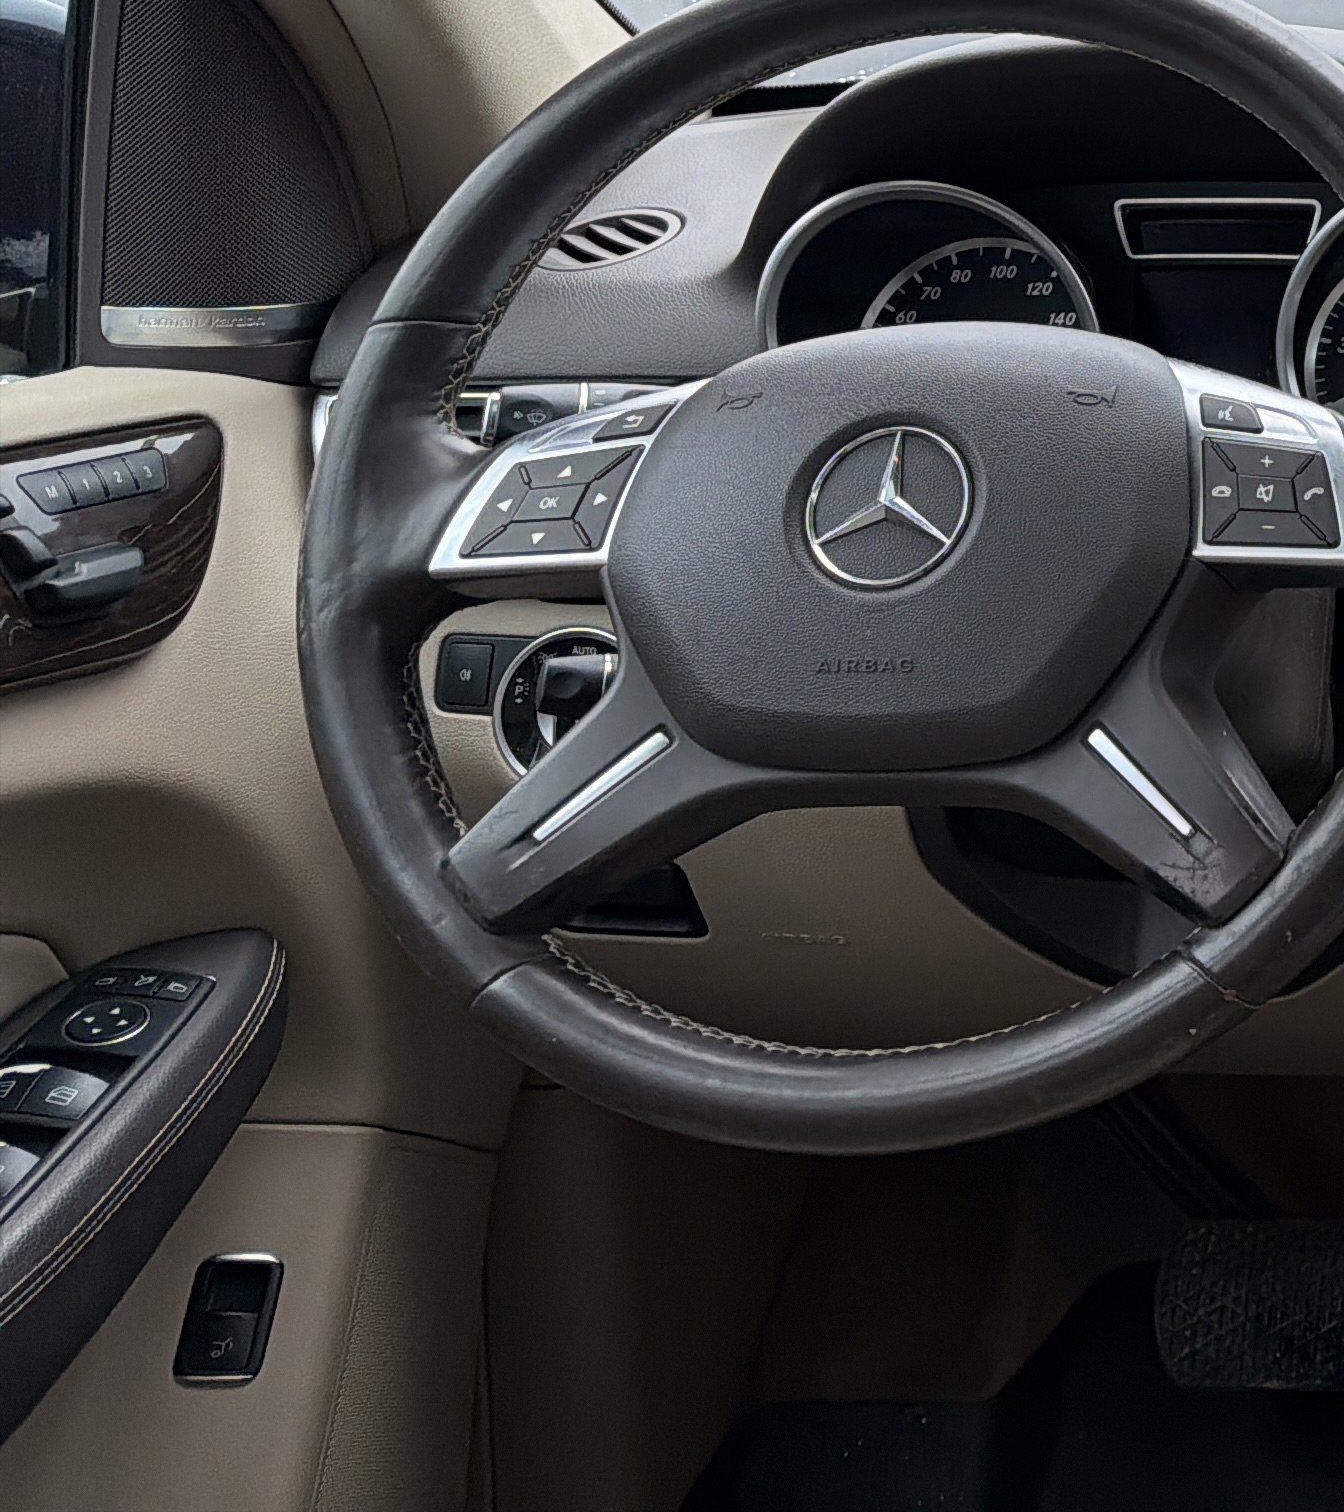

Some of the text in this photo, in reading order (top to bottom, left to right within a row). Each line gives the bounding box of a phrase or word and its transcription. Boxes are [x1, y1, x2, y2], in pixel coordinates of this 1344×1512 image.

[950, 269, 972, 283] 80
[989, 265, 1018, 280] 100
[919, 286, 941, 300] 70
[1025, 281, 1054, 297] 120
[895, 310, 917, 324] 60
[1049, 312, 1077, 326] 140
[113, 470, 123, 483] 2
[143, 465, 153, 478] 3
[83, 478, 90, 491] 1
[538, 497, 559, 509] OK
[571, 645, 597, 655] AUTO
[815, 657, 918, 674] AIRBAG
